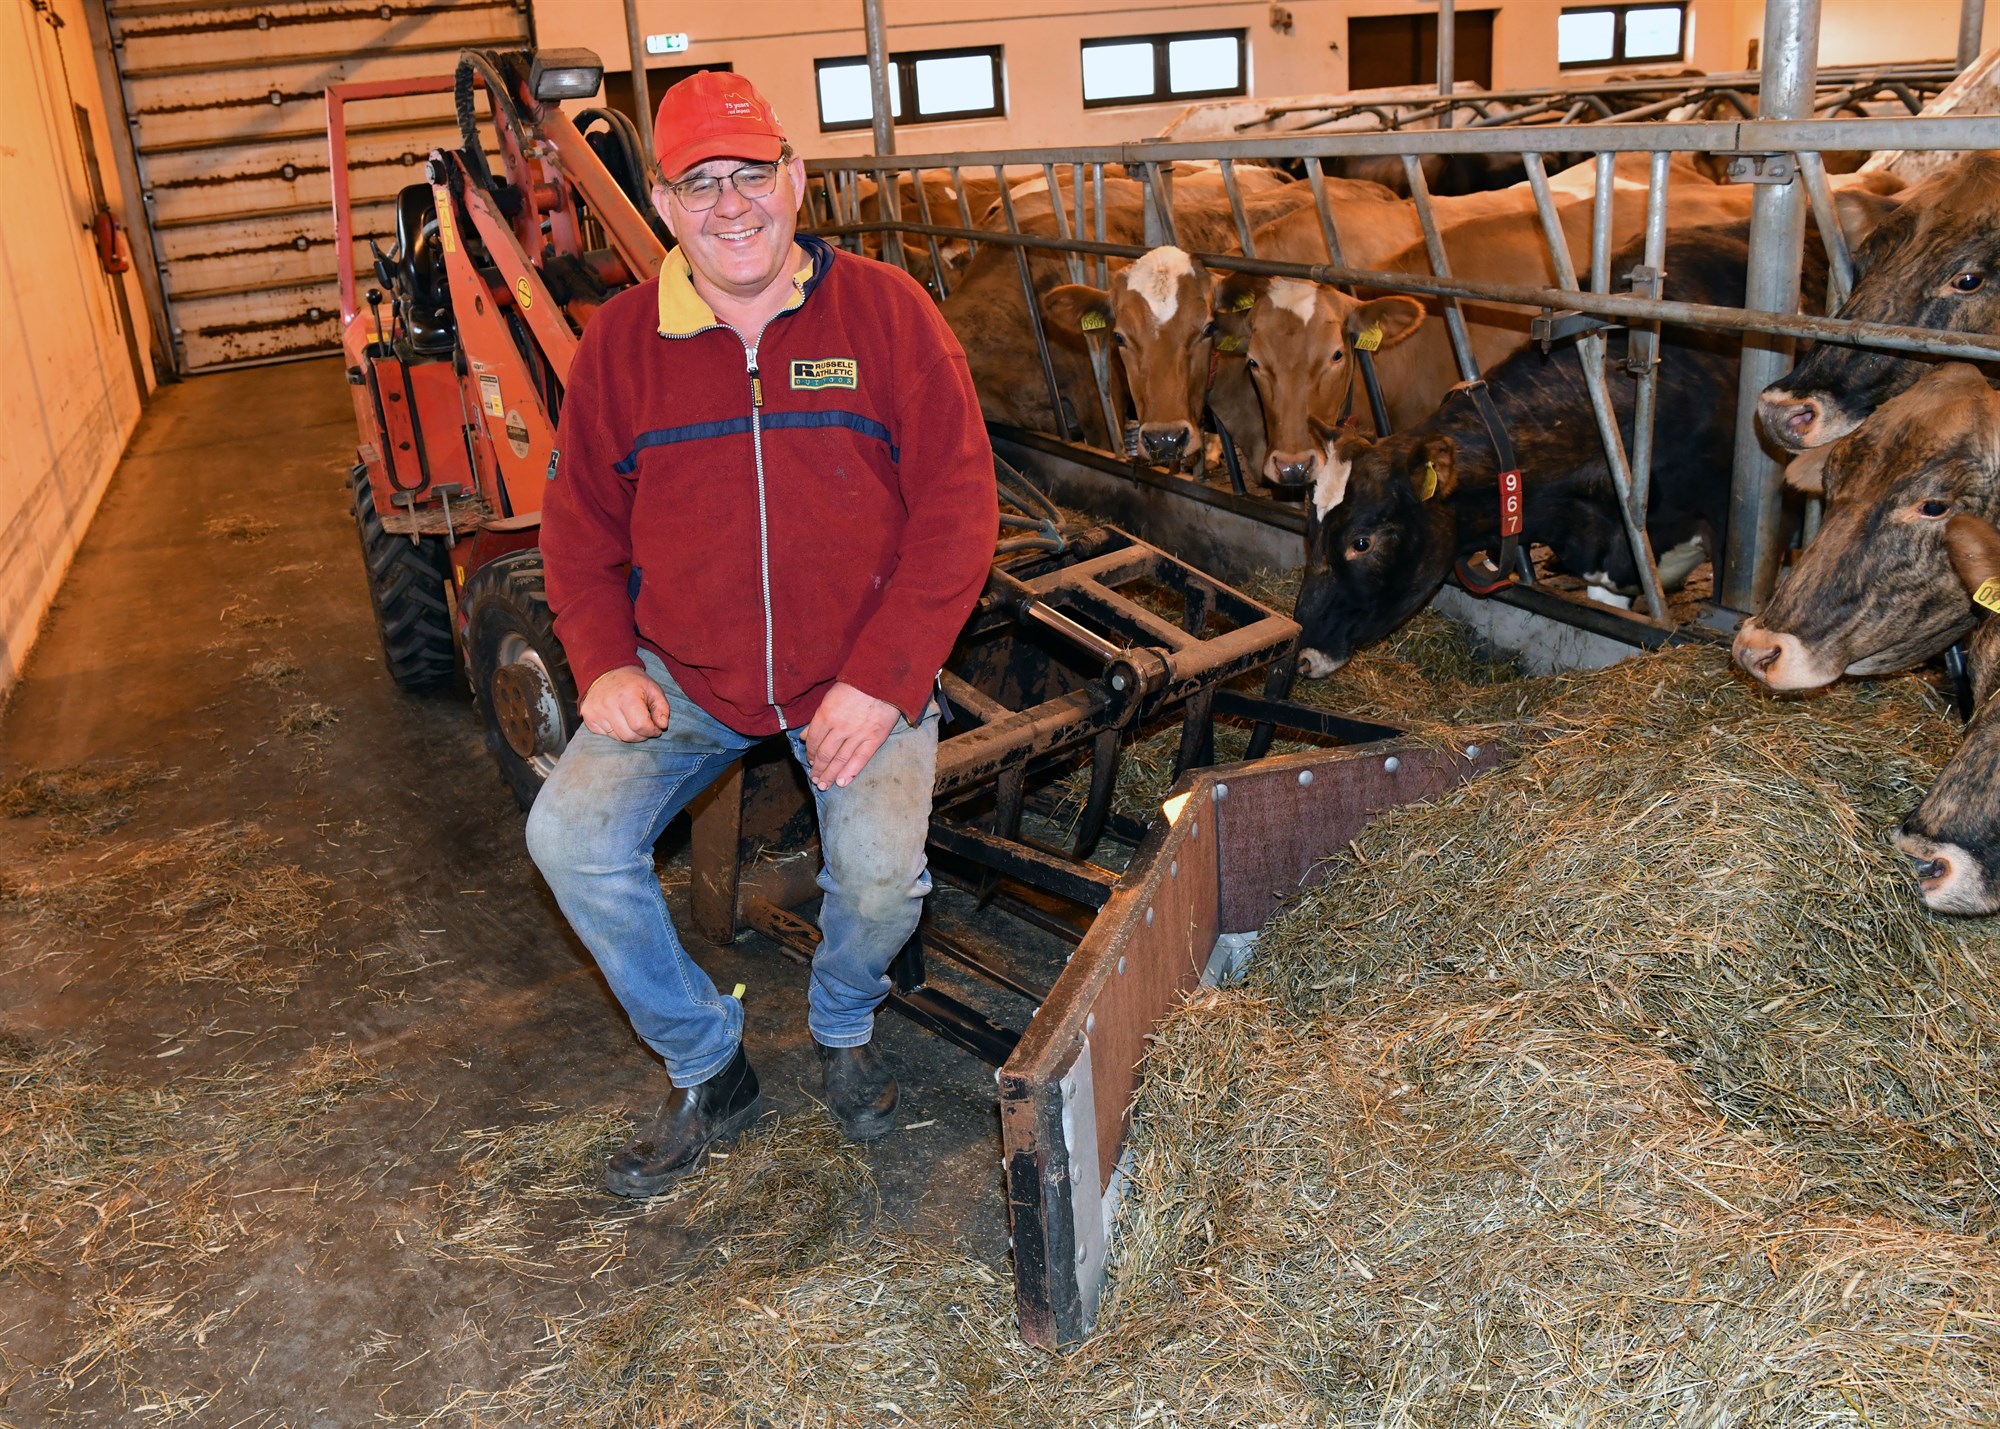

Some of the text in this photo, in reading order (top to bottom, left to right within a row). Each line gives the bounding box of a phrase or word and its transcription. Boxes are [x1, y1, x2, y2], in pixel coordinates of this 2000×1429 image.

[1357, 339, 1378, 349] 1009
[815, 361, 853, 370] RUSSELL
[815, 369, 853, 378] ATHLETIC
[1505, 473, 1518, 533] 967
[1978, 586, 2000, 611] 09
